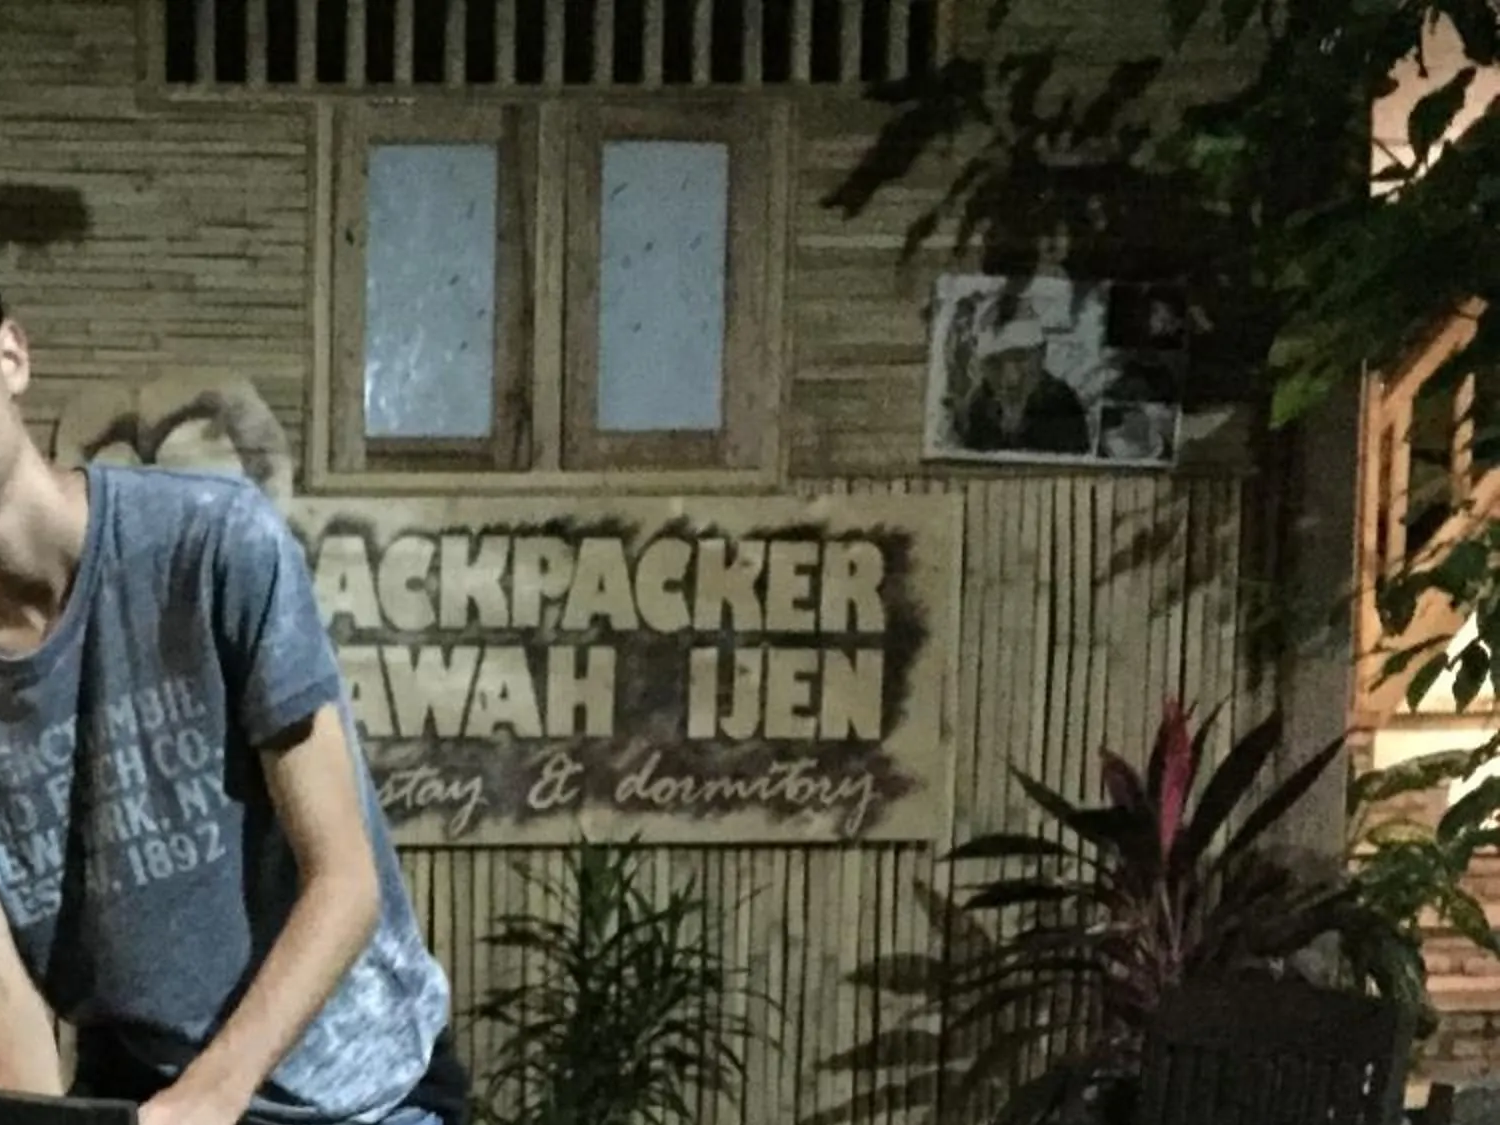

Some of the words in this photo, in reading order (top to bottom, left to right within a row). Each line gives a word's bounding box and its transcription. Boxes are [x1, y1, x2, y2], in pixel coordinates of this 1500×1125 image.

[313, 534, 886, 633] ACKPACKER
[338, 645, 615, 739] AWAH
[688, 645, 884, 740] IJEN
[375, 763, 490, 838] stay
[527, 752, 583, 809] &
[615, 751, 874, 836] dormitory
[127, 821, 227, 887] 1892
